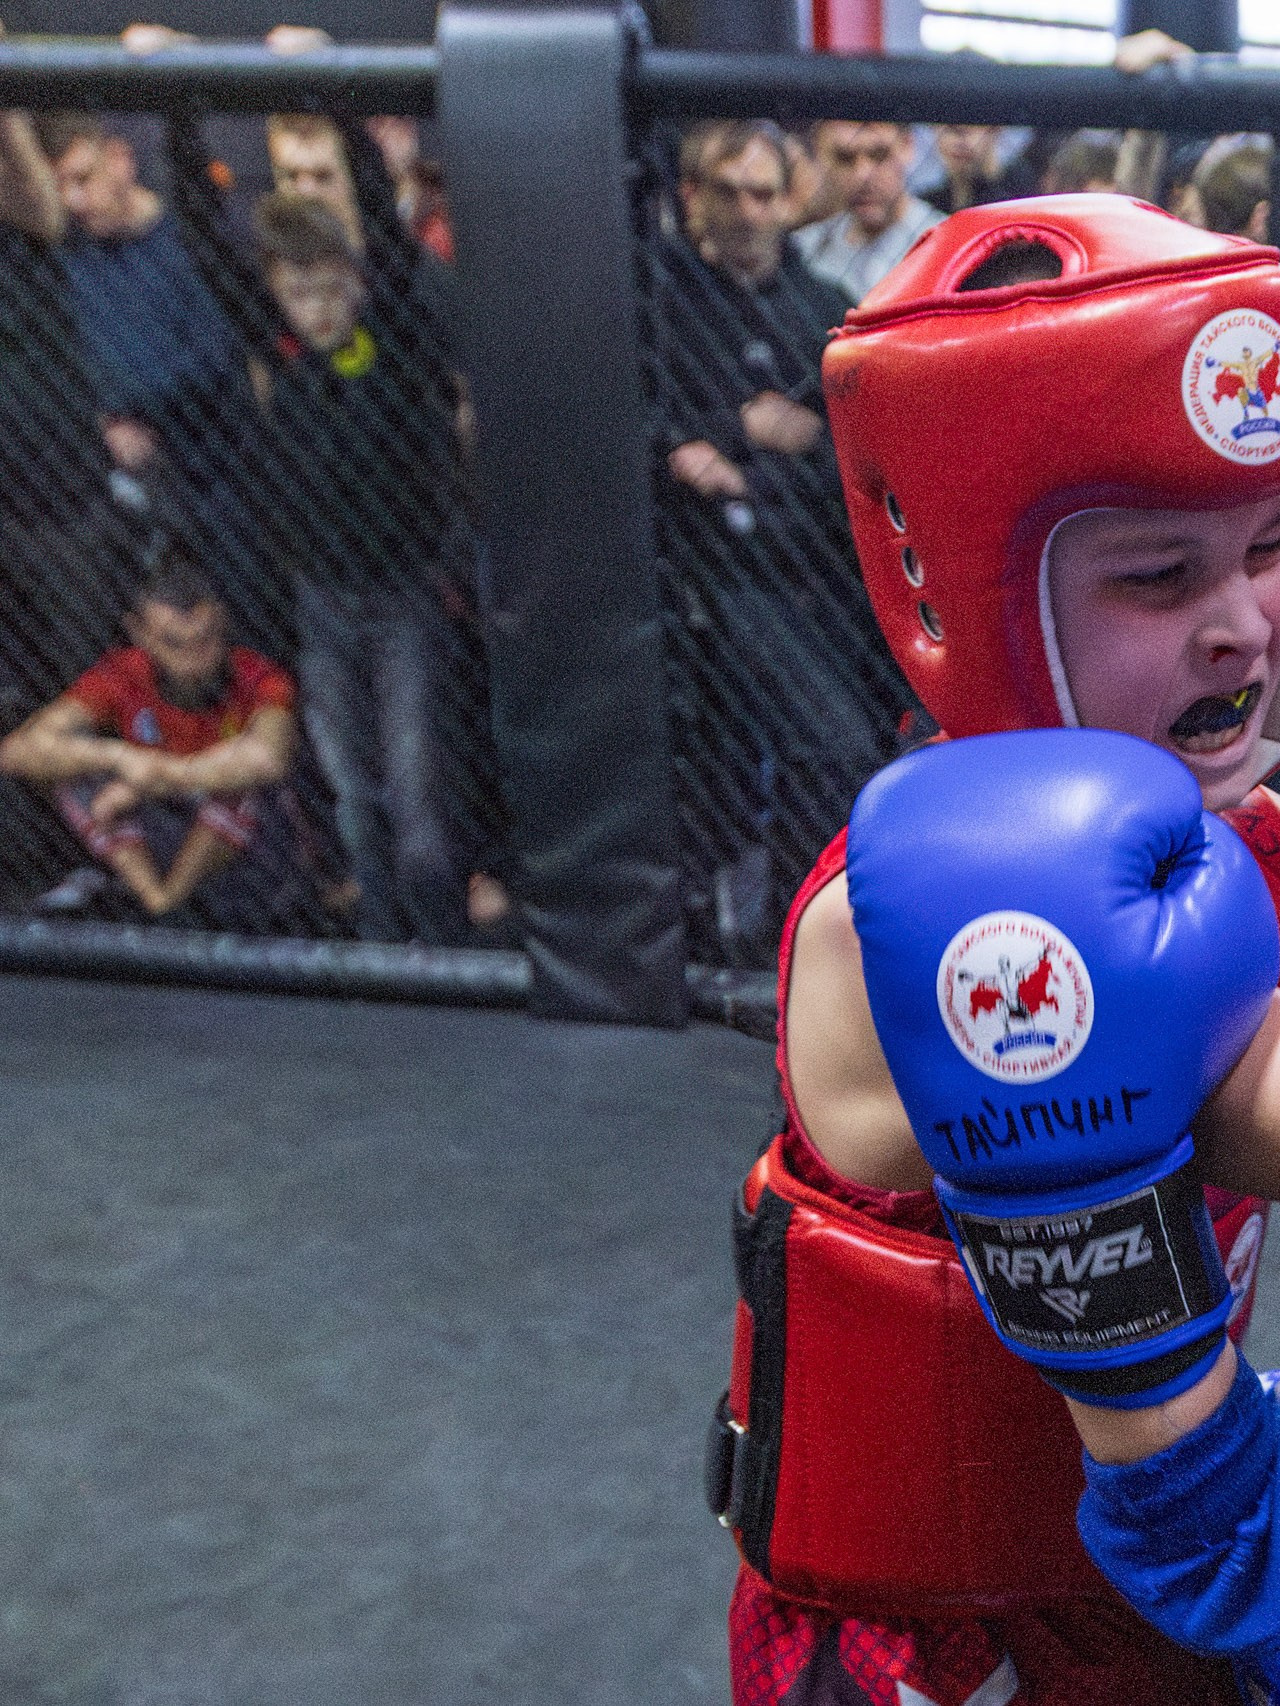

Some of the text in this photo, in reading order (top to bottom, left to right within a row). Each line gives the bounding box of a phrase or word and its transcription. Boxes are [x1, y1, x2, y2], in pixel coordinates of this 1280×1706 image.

[1200, 315, 1256, 349] ТАЙСКОГО
[1189, 351, 1215, 436] ФЕДЕРАЦИЯ
[982, 1223, 1153, 1290] REYVEL
